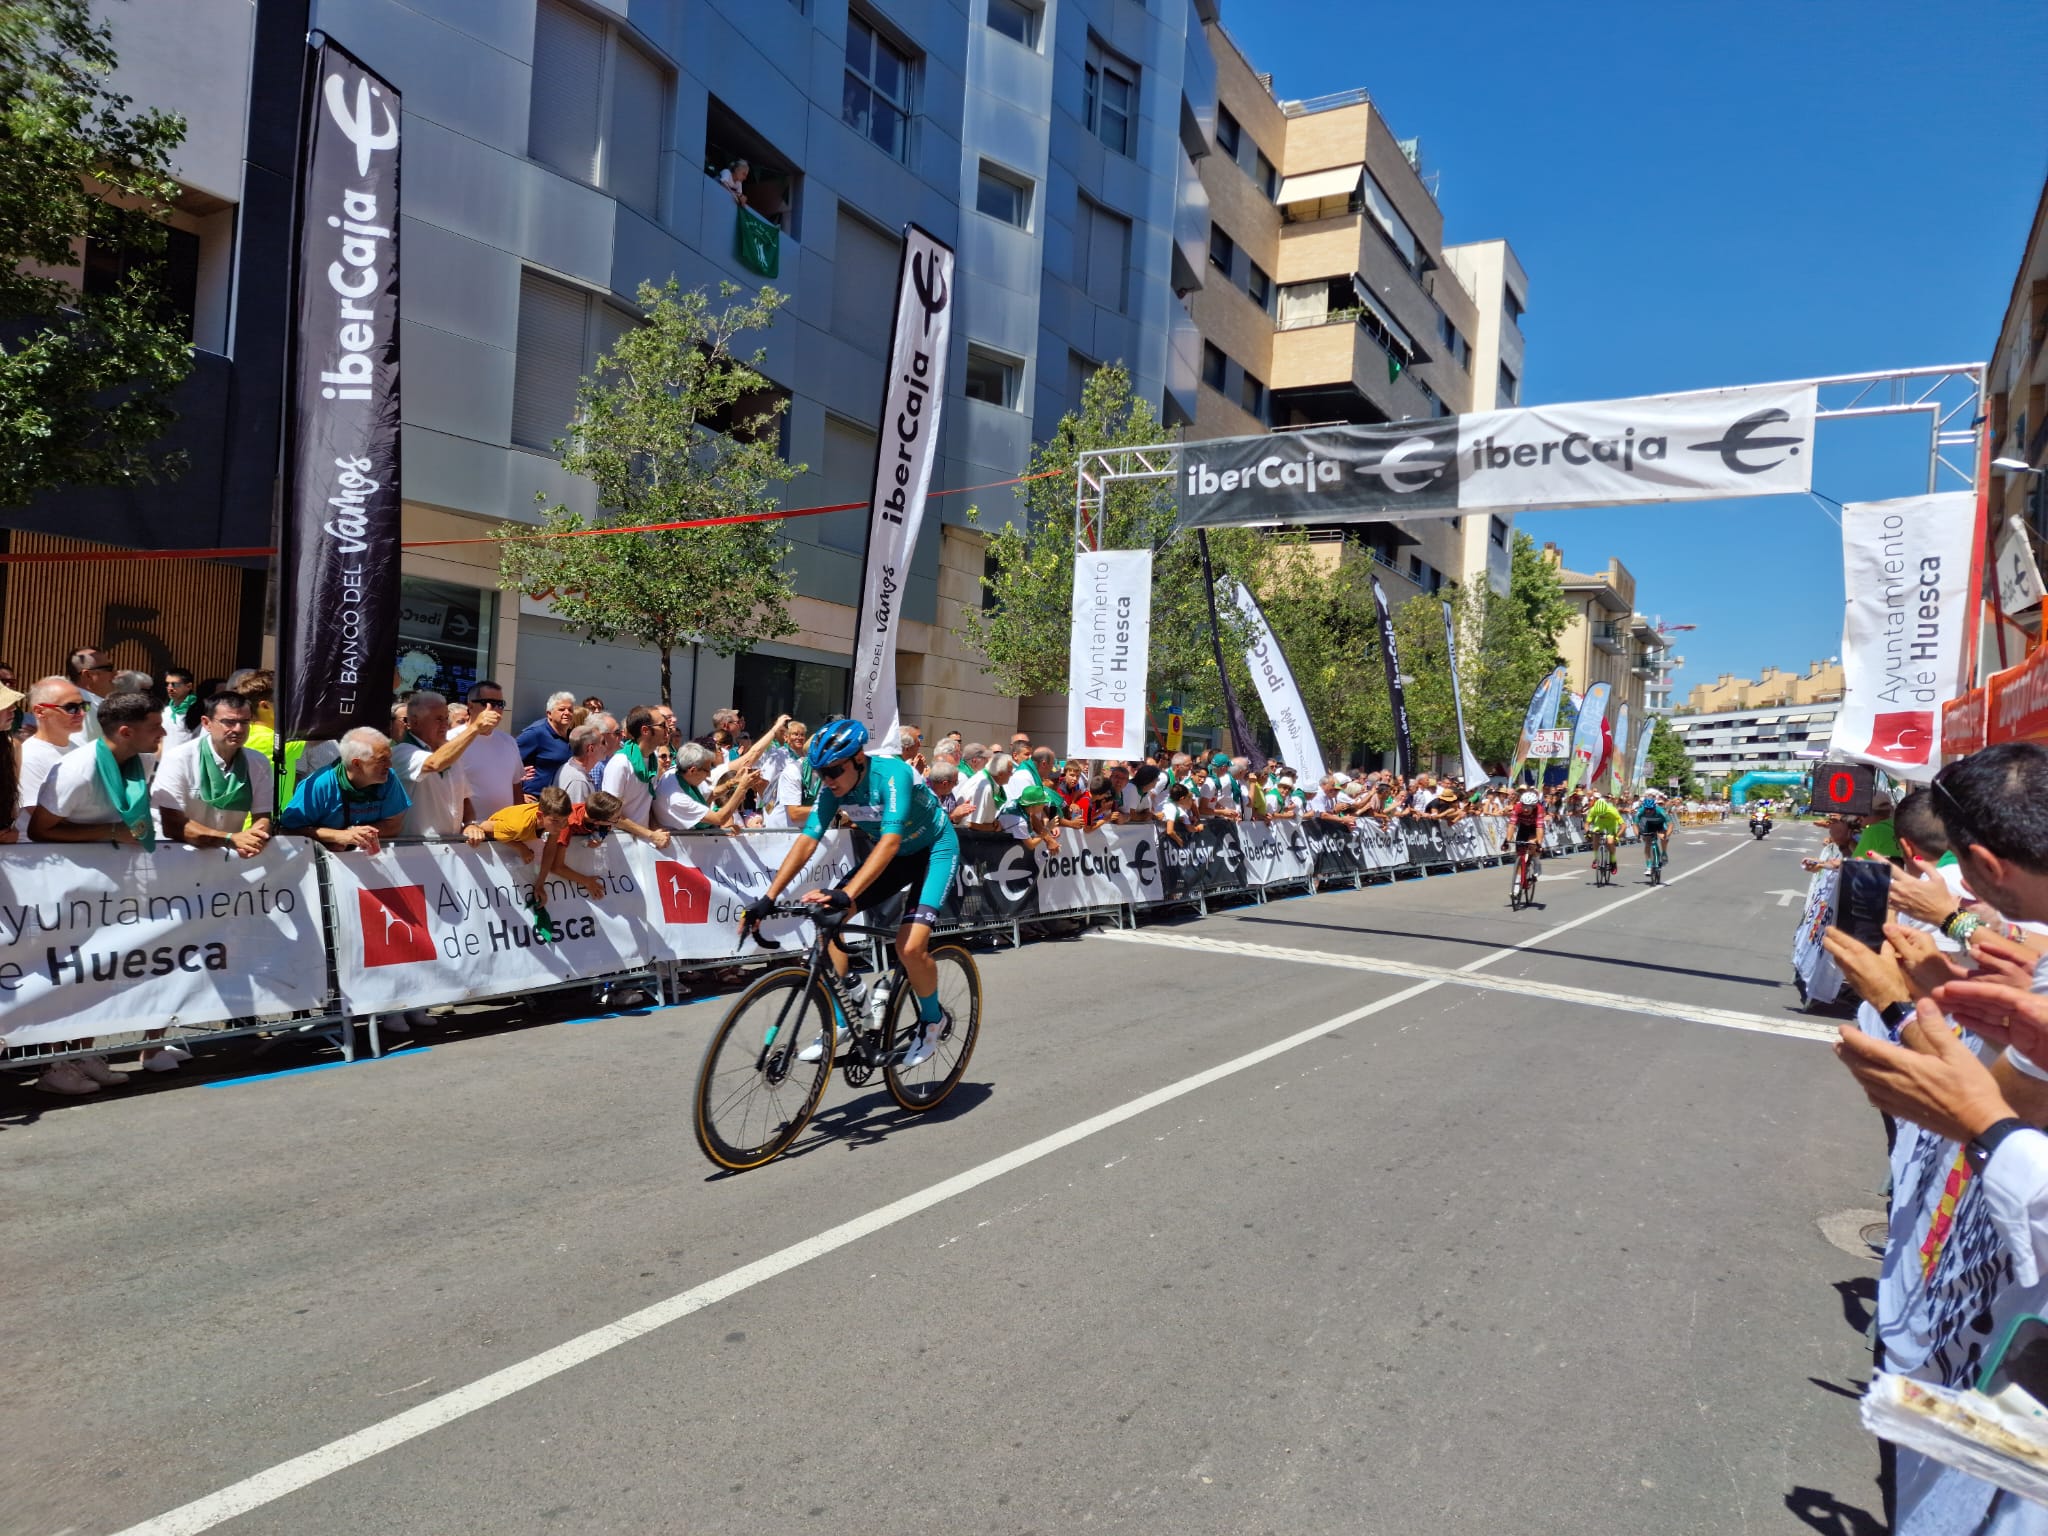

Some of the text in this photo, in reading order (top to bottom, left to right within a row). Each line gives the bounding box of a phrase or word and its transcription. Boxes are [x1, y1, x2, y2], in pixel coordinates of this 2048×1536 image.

[321, 189, 390, 400] iberCaja
[882, 350, 930, 526] iberCaja
[1473, 427, 1667, 471] iberCaja
[1188, 451, 1341, 496] iberCaja
[343, 563, 362, 602] DEL
[1877, 515, 1907, 704] Ayuntamiento
[340, 610, 360, 685] BANCO
[872, 640, 884, 672] DEL
[1086, 561, 1109, 701] Ayuntamiento
[1110, 596, 1131, 703] de Huesca
[1910, 555, 1941, 703] de Huesca
[339, 691, 357, 714] EL
[1042, 848, 1120, 882] iberCaja
[0, 883, 296, 947] yuntamiento
[46, 941, 228, 986] Huesca
[443, 926, 481, 959] de
